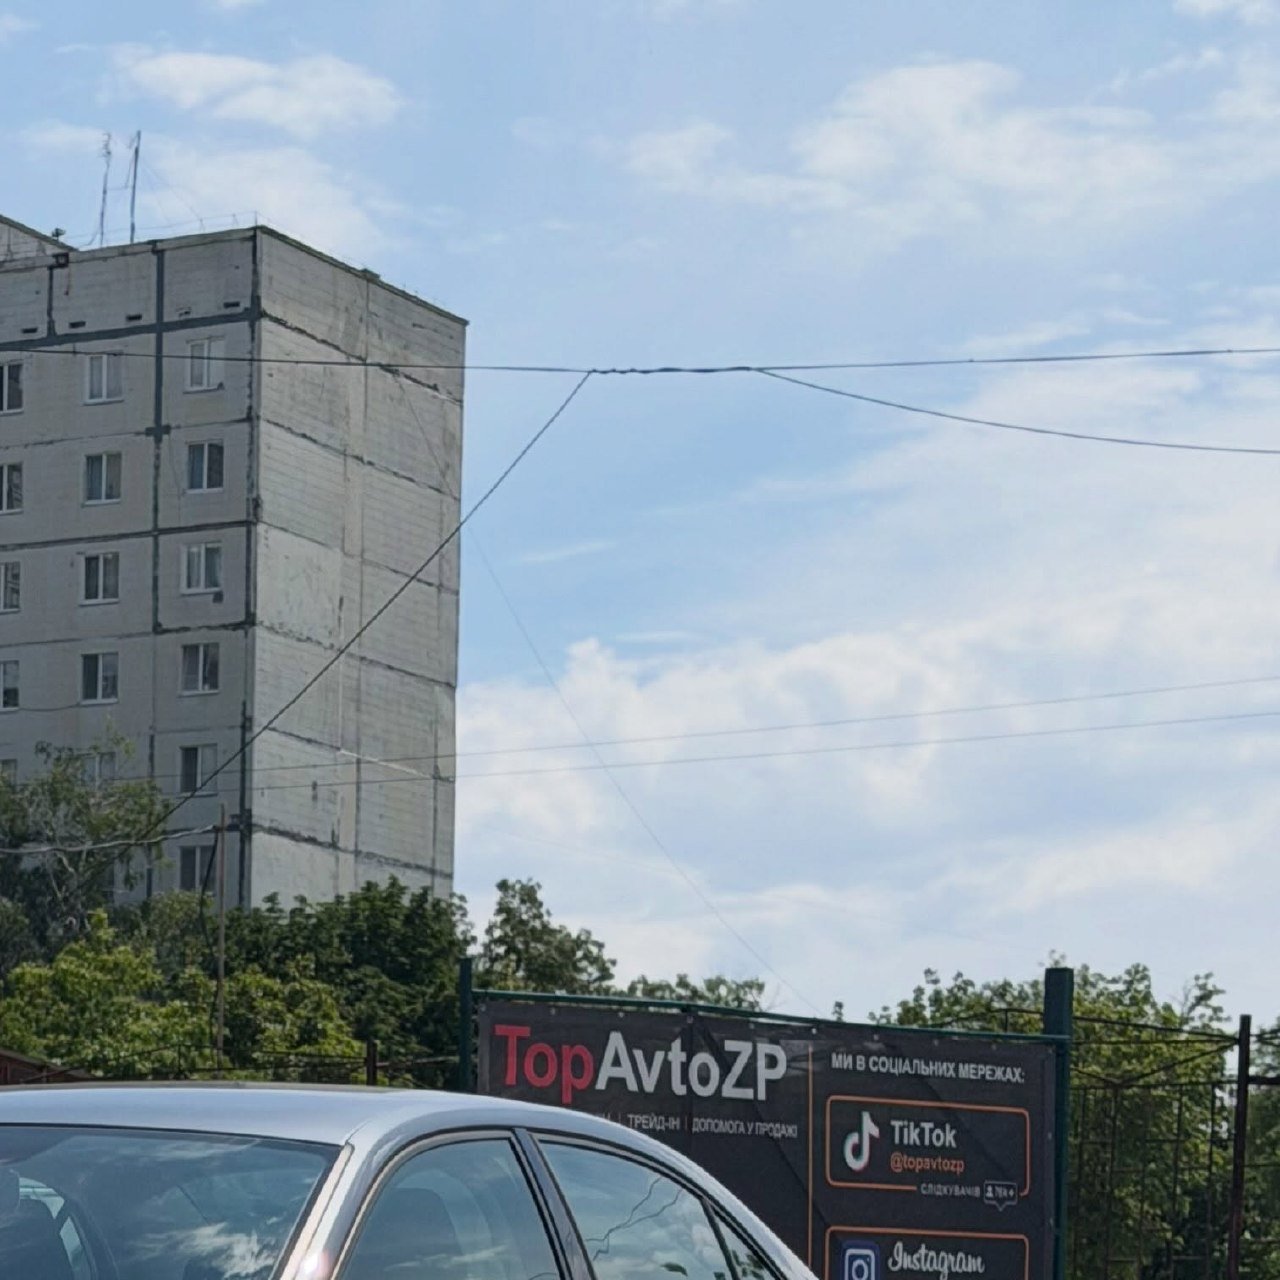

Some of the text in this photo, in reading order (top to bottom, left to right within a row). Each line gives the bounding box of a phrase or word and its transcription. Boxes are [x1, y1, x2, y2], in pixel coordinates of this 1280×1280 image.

[831, 1053, 853, 1069] МИ
[856, 1055, 866, 1071] В
[869, 1056, 956, 1077] СОЦІАЛЬНИХ
[692, 1117, 745, 1135] ДОПОМОГА
[745, 1121, 753, 1135] У
[891, 1120, 957, 1148] TikTok
[891, 1152, 964, 1175] @topavtozp
